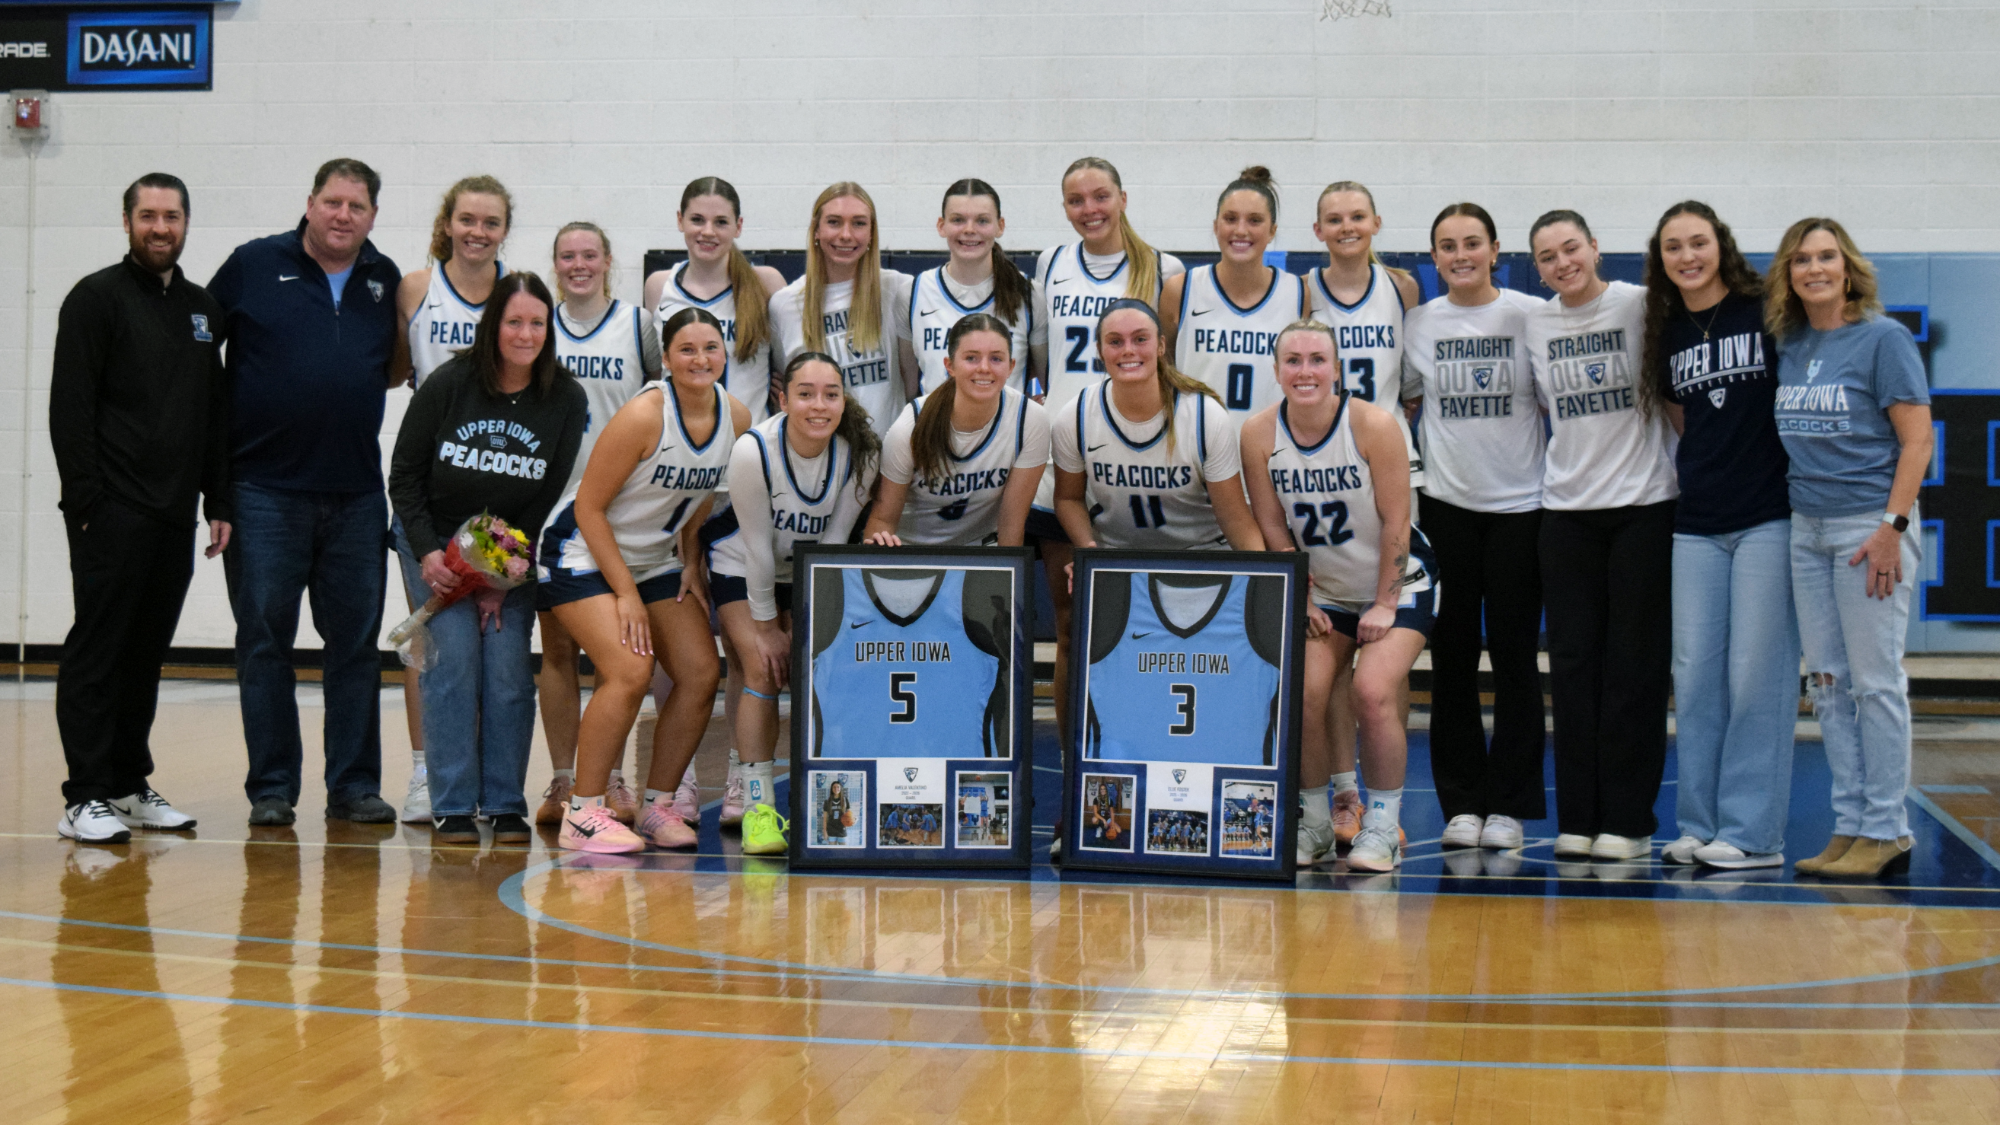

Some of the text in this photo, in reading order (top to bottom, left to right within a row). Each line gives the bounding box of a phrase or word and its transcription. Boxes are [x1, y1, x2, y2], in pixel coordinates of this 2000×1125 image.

[84, 29, 191, 67] DASANI
[1053, 295, 1118, 318] PEACO
[430, 321, 478, 345] PEAC
[1195, 328, 1278, 356] PEACOCK
[1548, 330, 1622, 360] STRAIGHT
[1436, 338, 1512, 360] STRAIGHT
[1670, 343, 1710, 386] UPPER
[1718, 331, 1765, 370] IOWA
[557, 354, 624, 381] COCKS
[1226, 362, 1254, 412] 0
[1775, 384, 1850, 412] PPER IOWA
[1440, 395, 1512, 418] FAYETTE
[1556, 387, 1633, 419] FAYETTE
[456, 419, 541, 454] UPPER IOWA
[1778, 419, 1851, 432] ACOCKS
[439, 441, 547, 480] PEACOCKS
[1093, 461, 1192, 489] PEACOCKS
[1271, 464, 1362, 494] PEACOCKS
[1129, 494, 1167, 529] 11
[1292, 499, 1355, 547] 22
[855, 641, 951, 662] UPPER IOWA
[1138, 652, 1230, 675] UPPER IOWA
[889, 671, 917, 724] 5
[1168, 683, 1197, 736] 3
